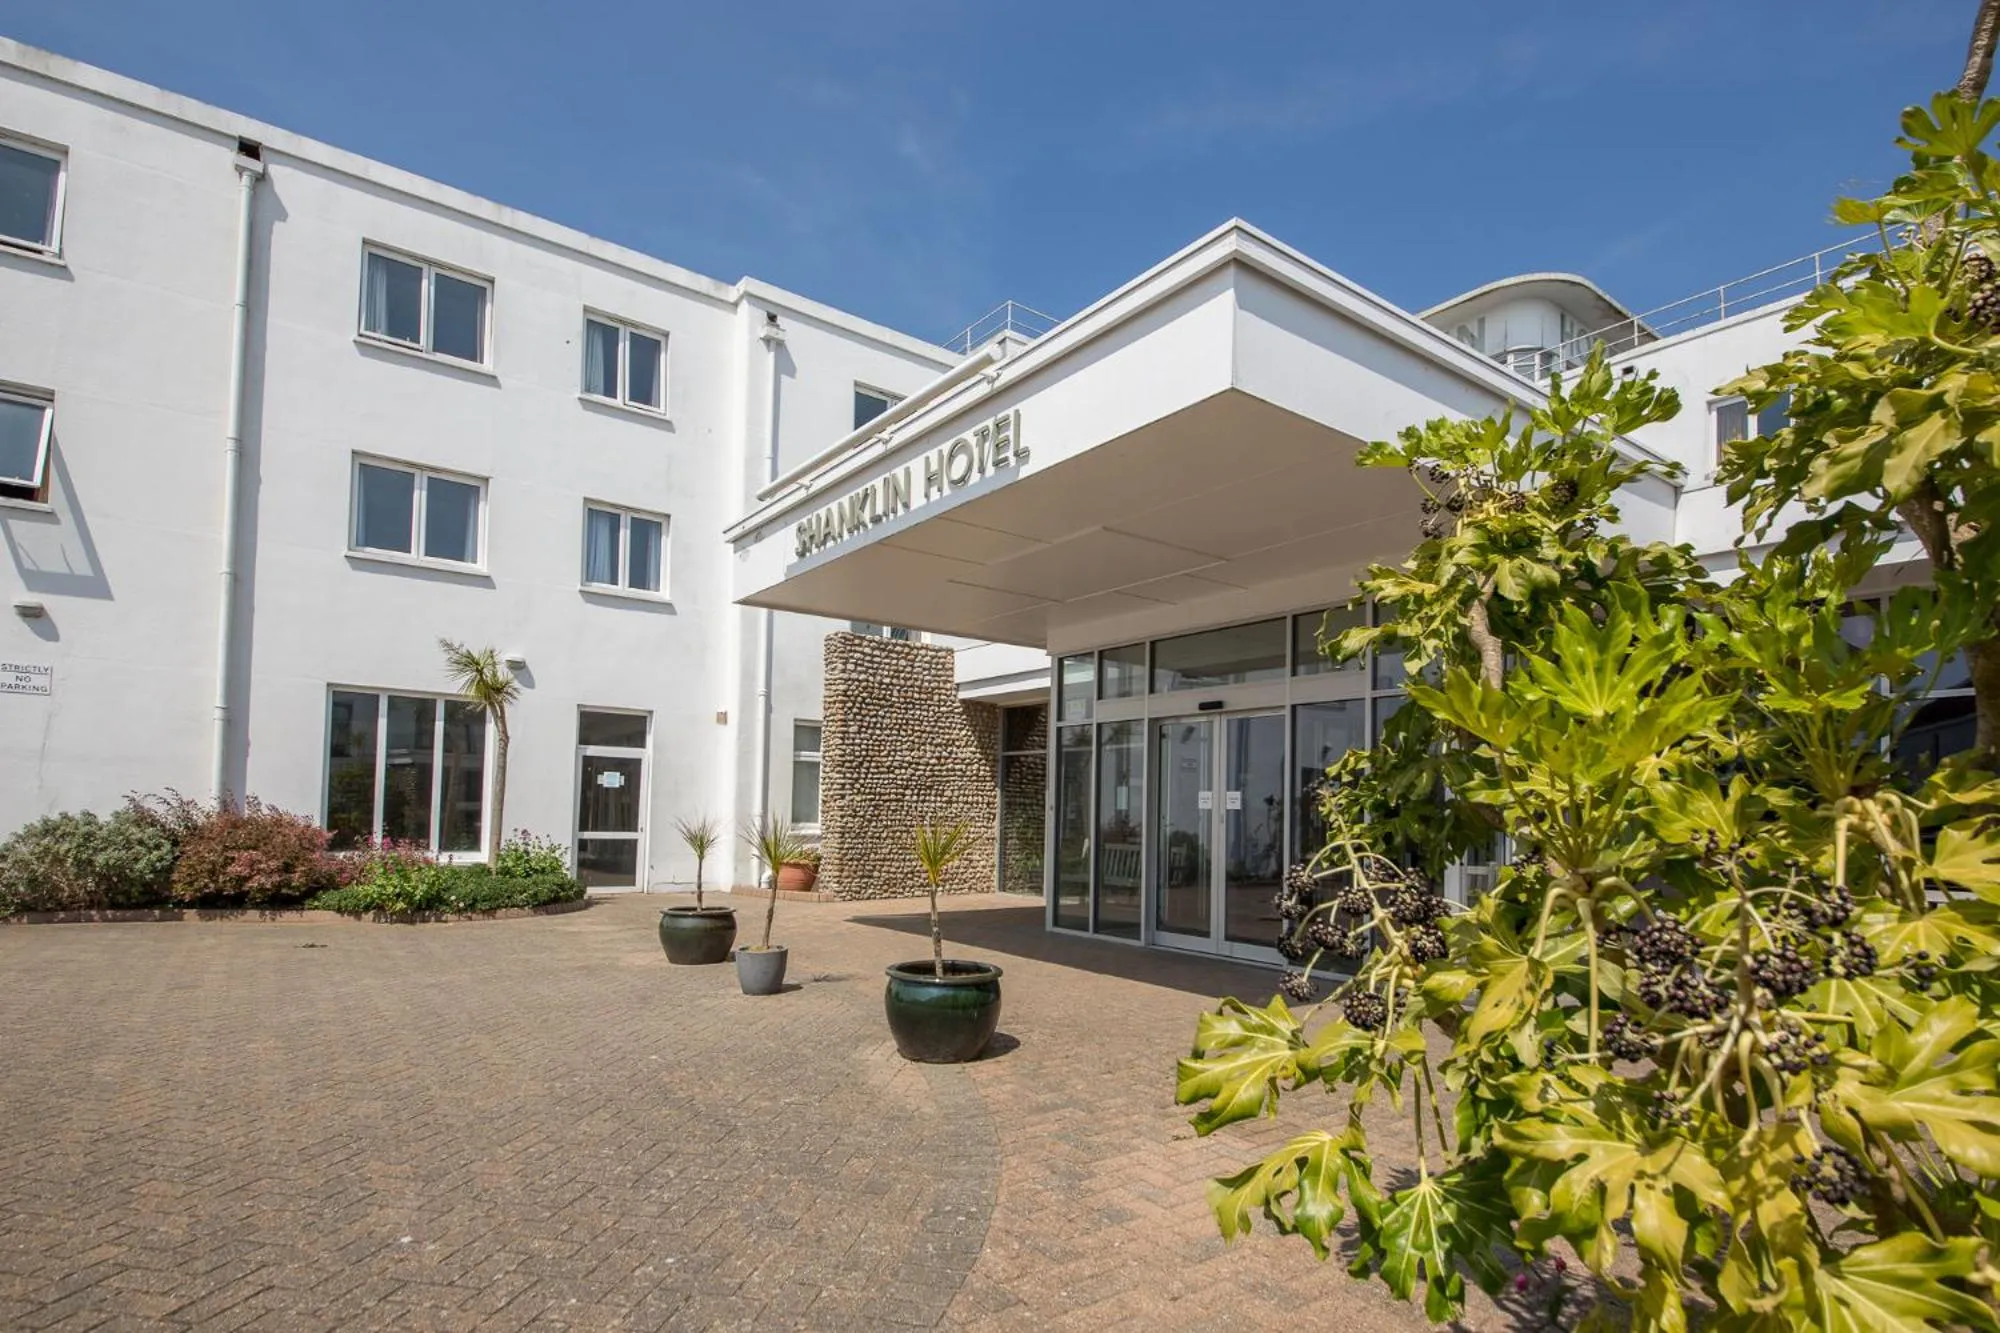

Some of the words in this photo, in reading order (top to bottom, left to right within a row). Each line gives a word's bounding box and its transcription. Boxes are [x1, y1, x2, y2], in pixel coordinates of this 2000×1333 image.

[795, 465, 912, 558] SHANKLIN
[924, 408, 1031, 501] HOTEL
[0, 663, 49, 673] STRICTLY
[15, 675, 32, 683] NO
[0, 682, 48, 693] PARKING
